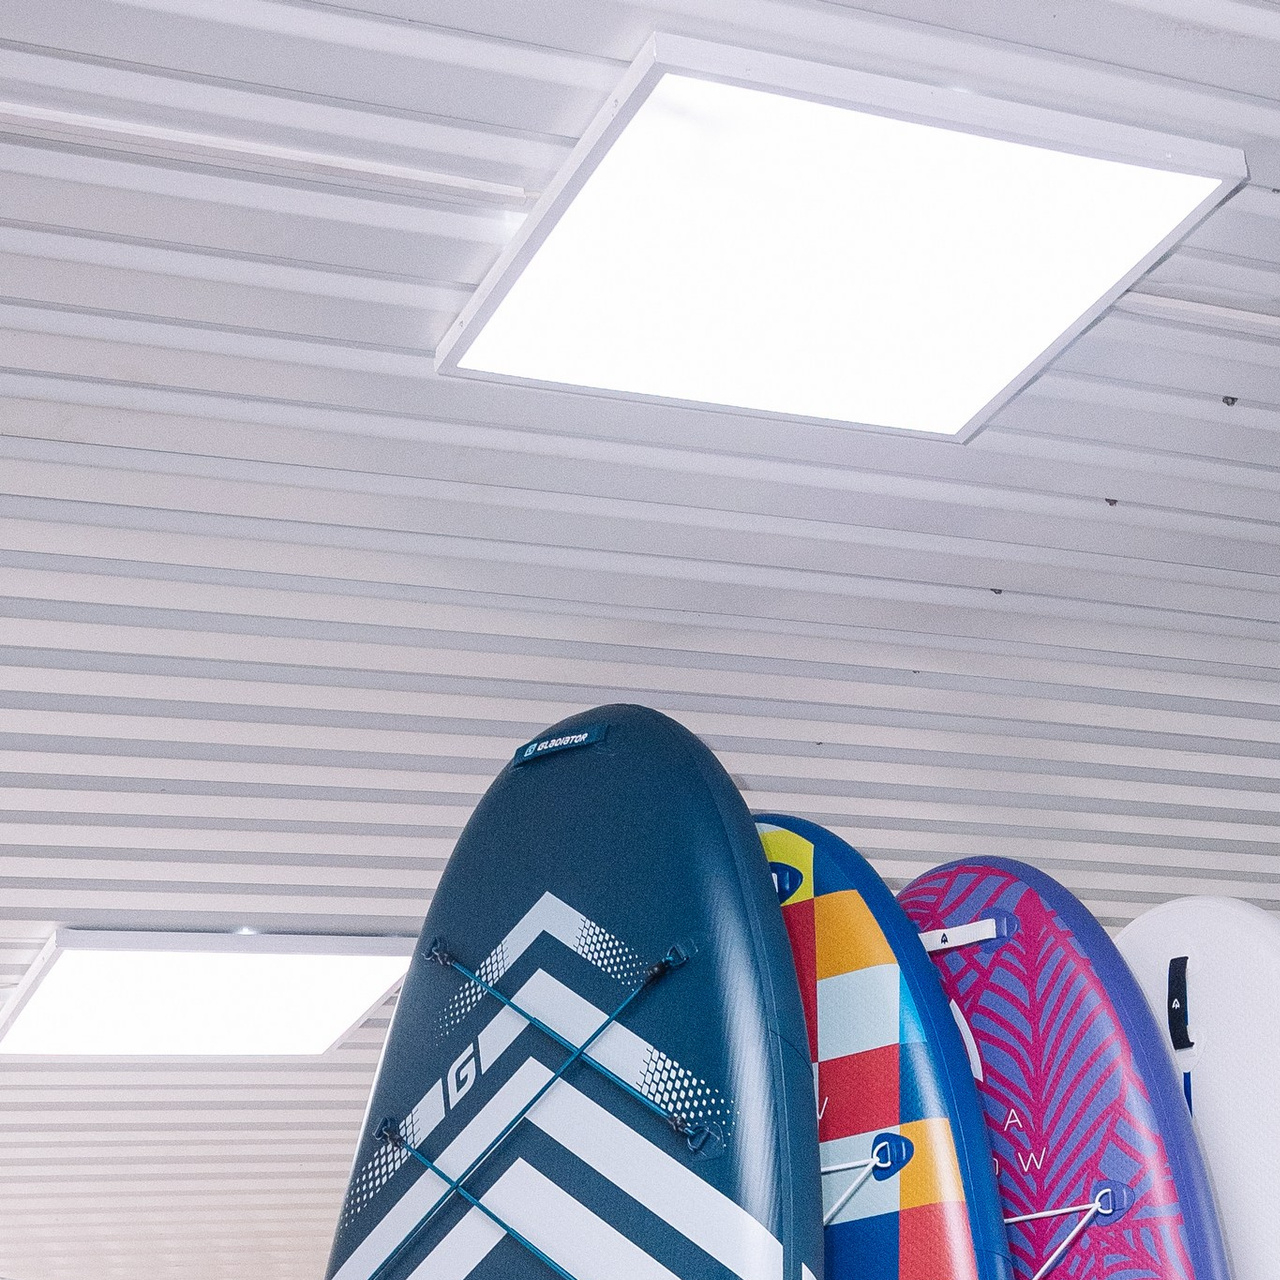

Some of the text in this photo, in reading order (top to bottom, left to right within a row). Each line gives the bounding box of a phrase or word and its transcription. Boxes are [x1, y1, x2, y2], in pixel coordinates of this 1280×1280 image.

[537, 733, 588, 751] GLADIATOR
[443, 1044, 478, 1111] G
[1004, 1108, 1023, 1132] A
[1017, 1146, 1046, 1172] W
